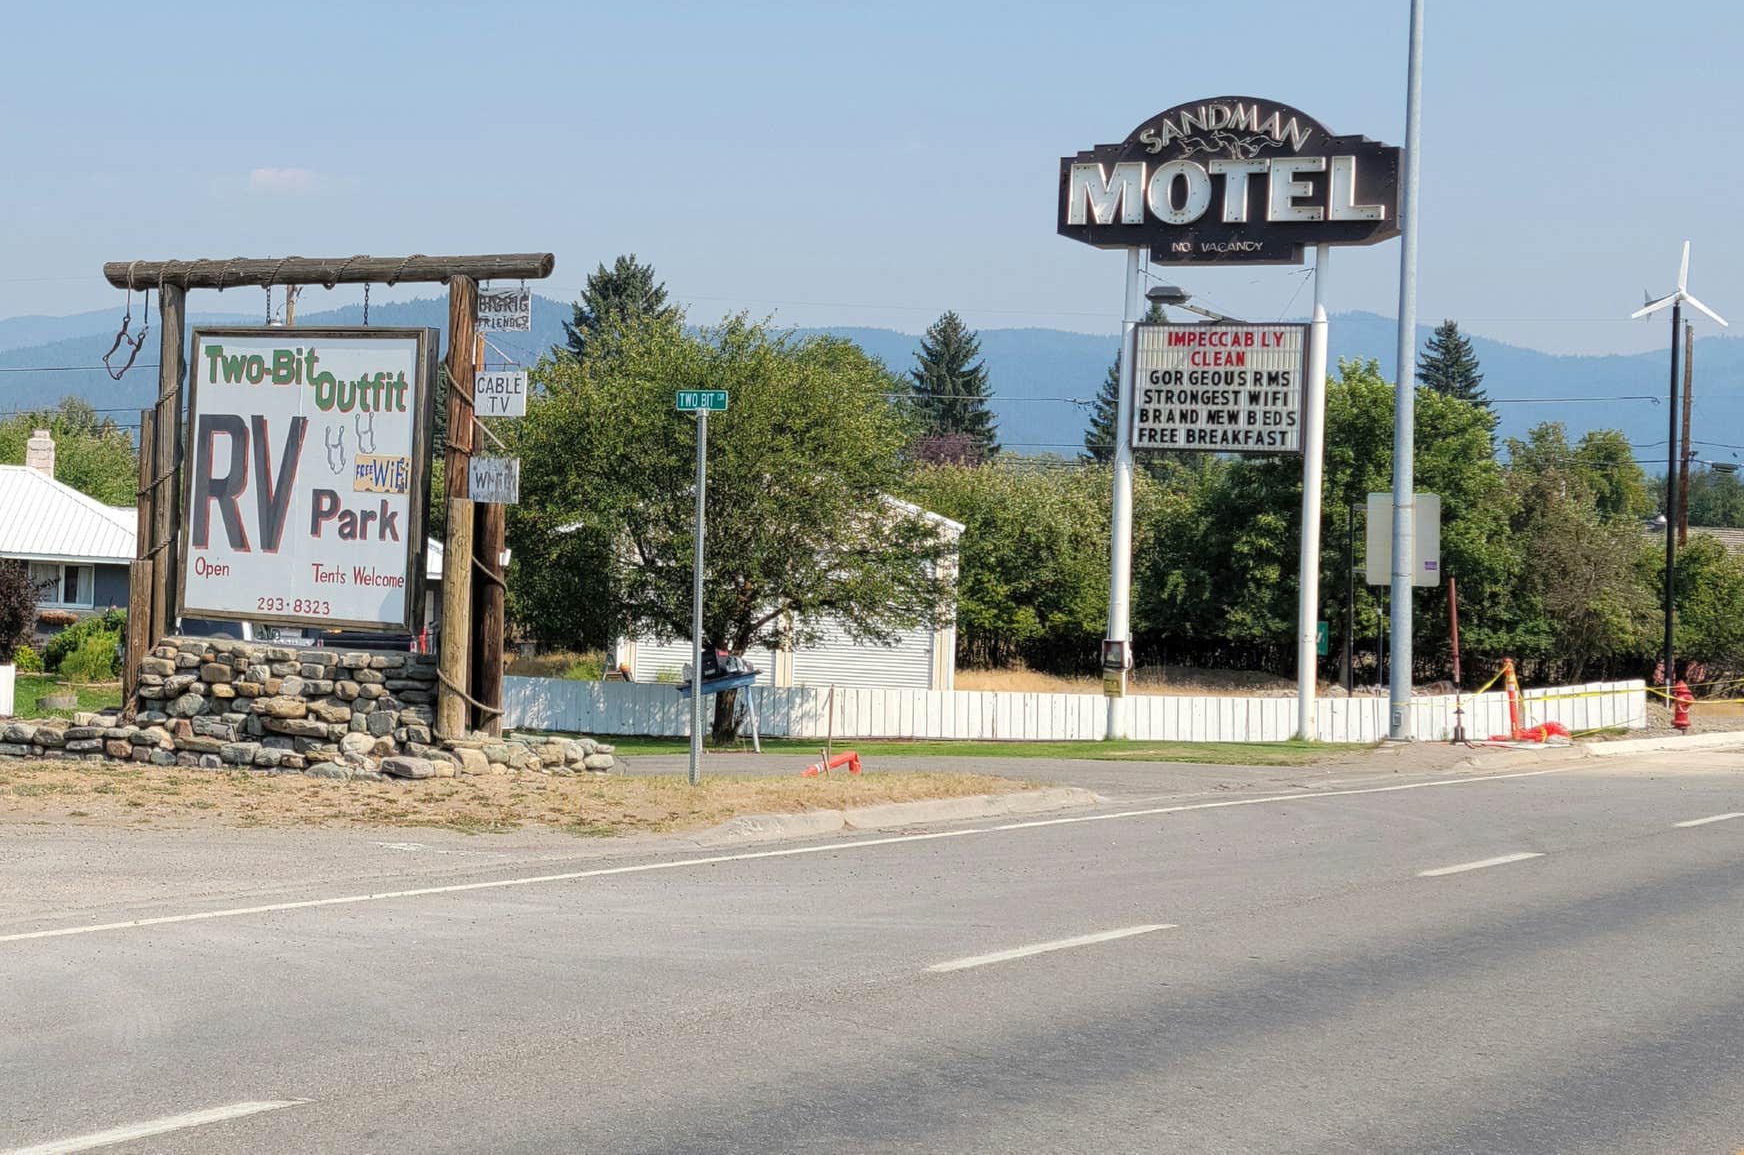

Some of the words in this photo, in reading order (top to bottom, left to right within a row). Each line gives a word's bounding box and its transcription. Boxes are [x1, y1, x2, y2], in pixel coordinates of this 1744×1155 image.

[1140, 103, 1312, 154] SANDMAN
[1067, 155, 1385, 225] MOTEL
[1172, 241, 1191, 252] NO
[1201, 241, 1263, 252] VACANCY
[1167, 332, 1284, 347] IMPECCABLY
[1191, 351, 1245, 366] CLEAN
[205, 345, 319, 386] Two-Bit
[315, 370, 408, 412] Outfit
[477, 377, 522, 394] CABLE
[1150, 370, 1247, 386] GORGEOUS
[1254, 371, 1290, 387] RMS
[489, 396, 510, 413] TV
[680, 393, 698, 407] TWO
[701, 393, 714, 407] BIT
[1144, 389, 1241, 405] STRONGEST
[1248, 391, 1288, 406] WIFI
[1139, 409, 1199, 424] BRAND
[1206, 410, 1240, 425] NEW
[1247, 410, 1296, 426] BEDS
[1139, 428, 1178, 443] FREE
[1186, 429, 1288, 446] BREAKFAST
[192, 414, 309, 554] RV
[311, 489, 400, 542] Park
[195, 556, 229, 579] Open
[312, 563, 346, 584] Tents
[353, 566, 405, 588] Welcome
